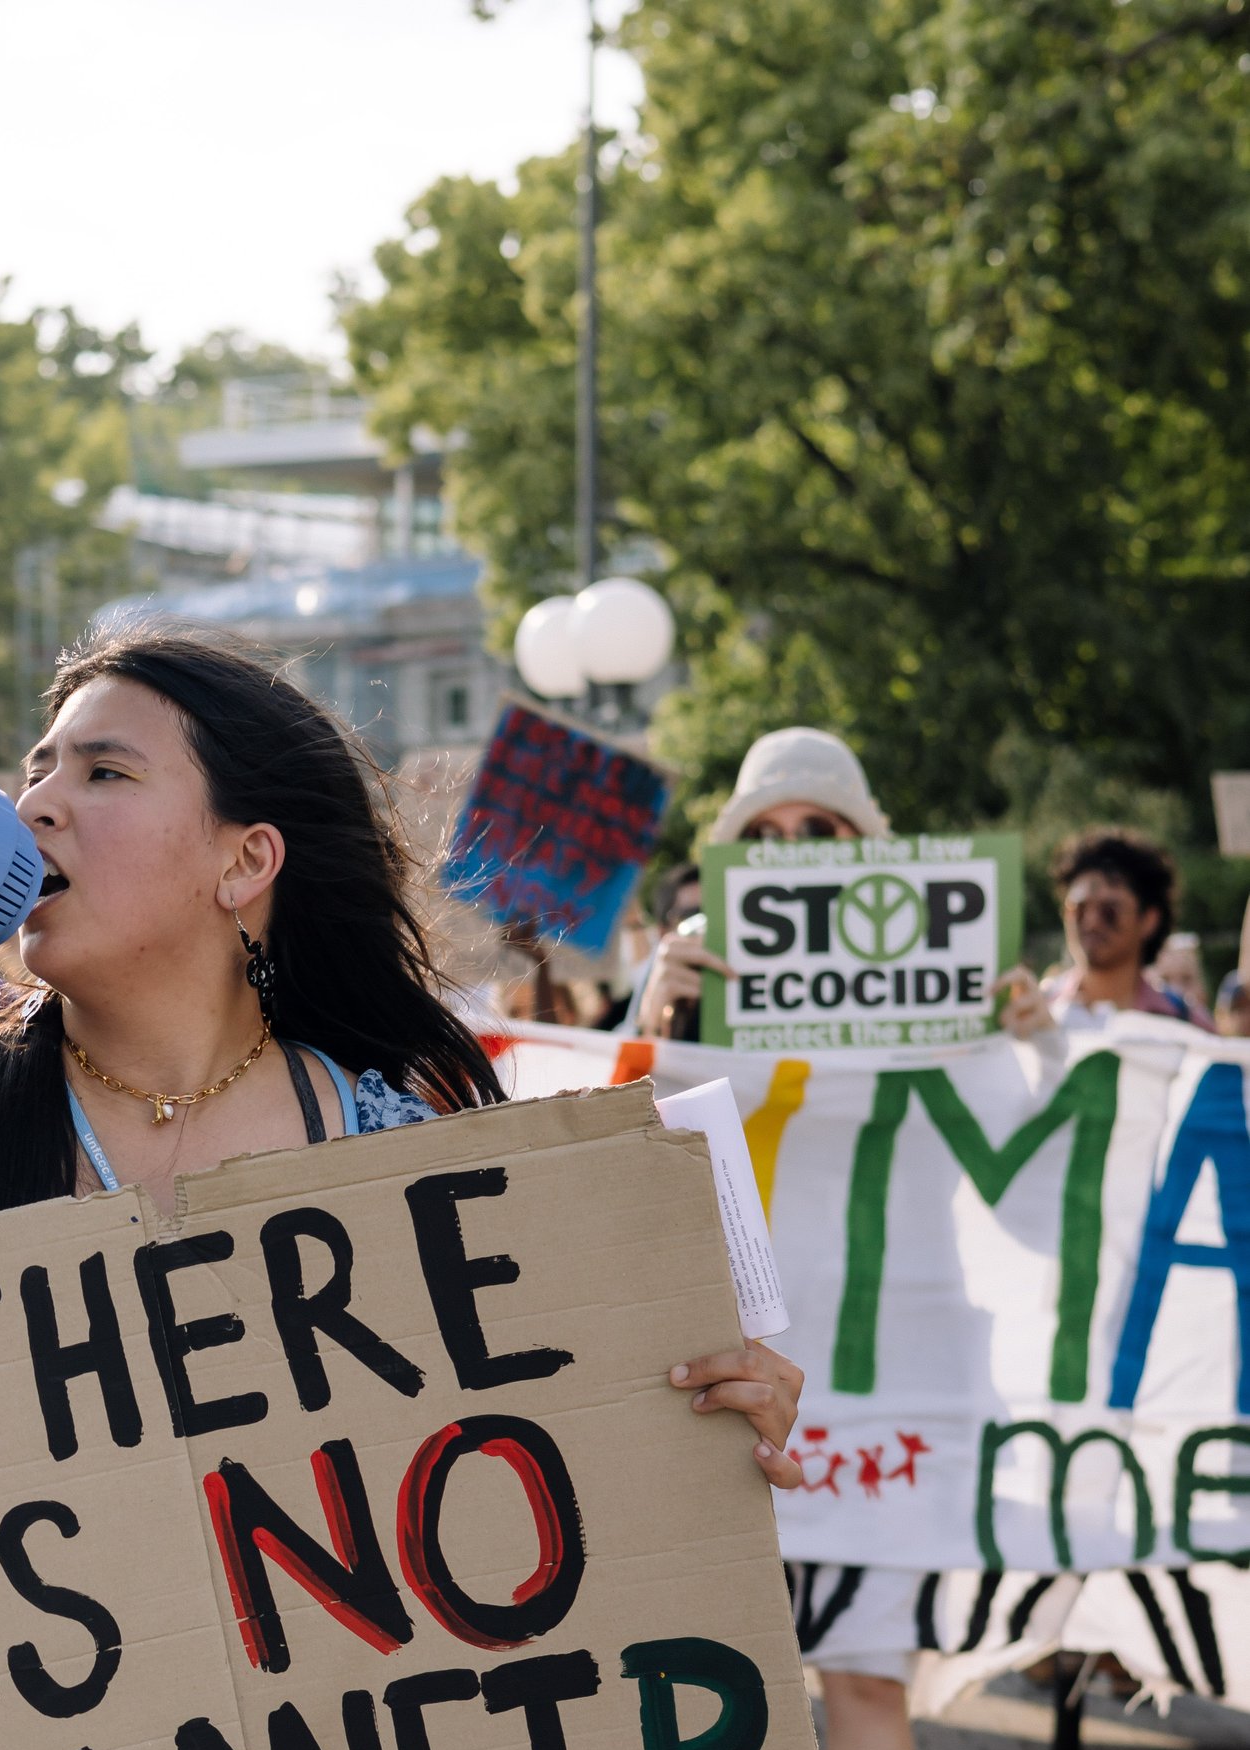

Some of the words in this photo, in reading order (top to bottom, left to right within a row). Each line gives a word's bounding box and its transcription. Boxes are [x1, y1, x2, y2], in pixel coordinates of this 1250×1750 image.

[746, 838, 856, 867] change
[861, 837, 913, 863] the
[918, 833, 974, 861] law
[740, 966, 985, 1011] ECOCIDE
[850, 1020, 901, 1046] the
[203, 1413, 588, 1674] NO
